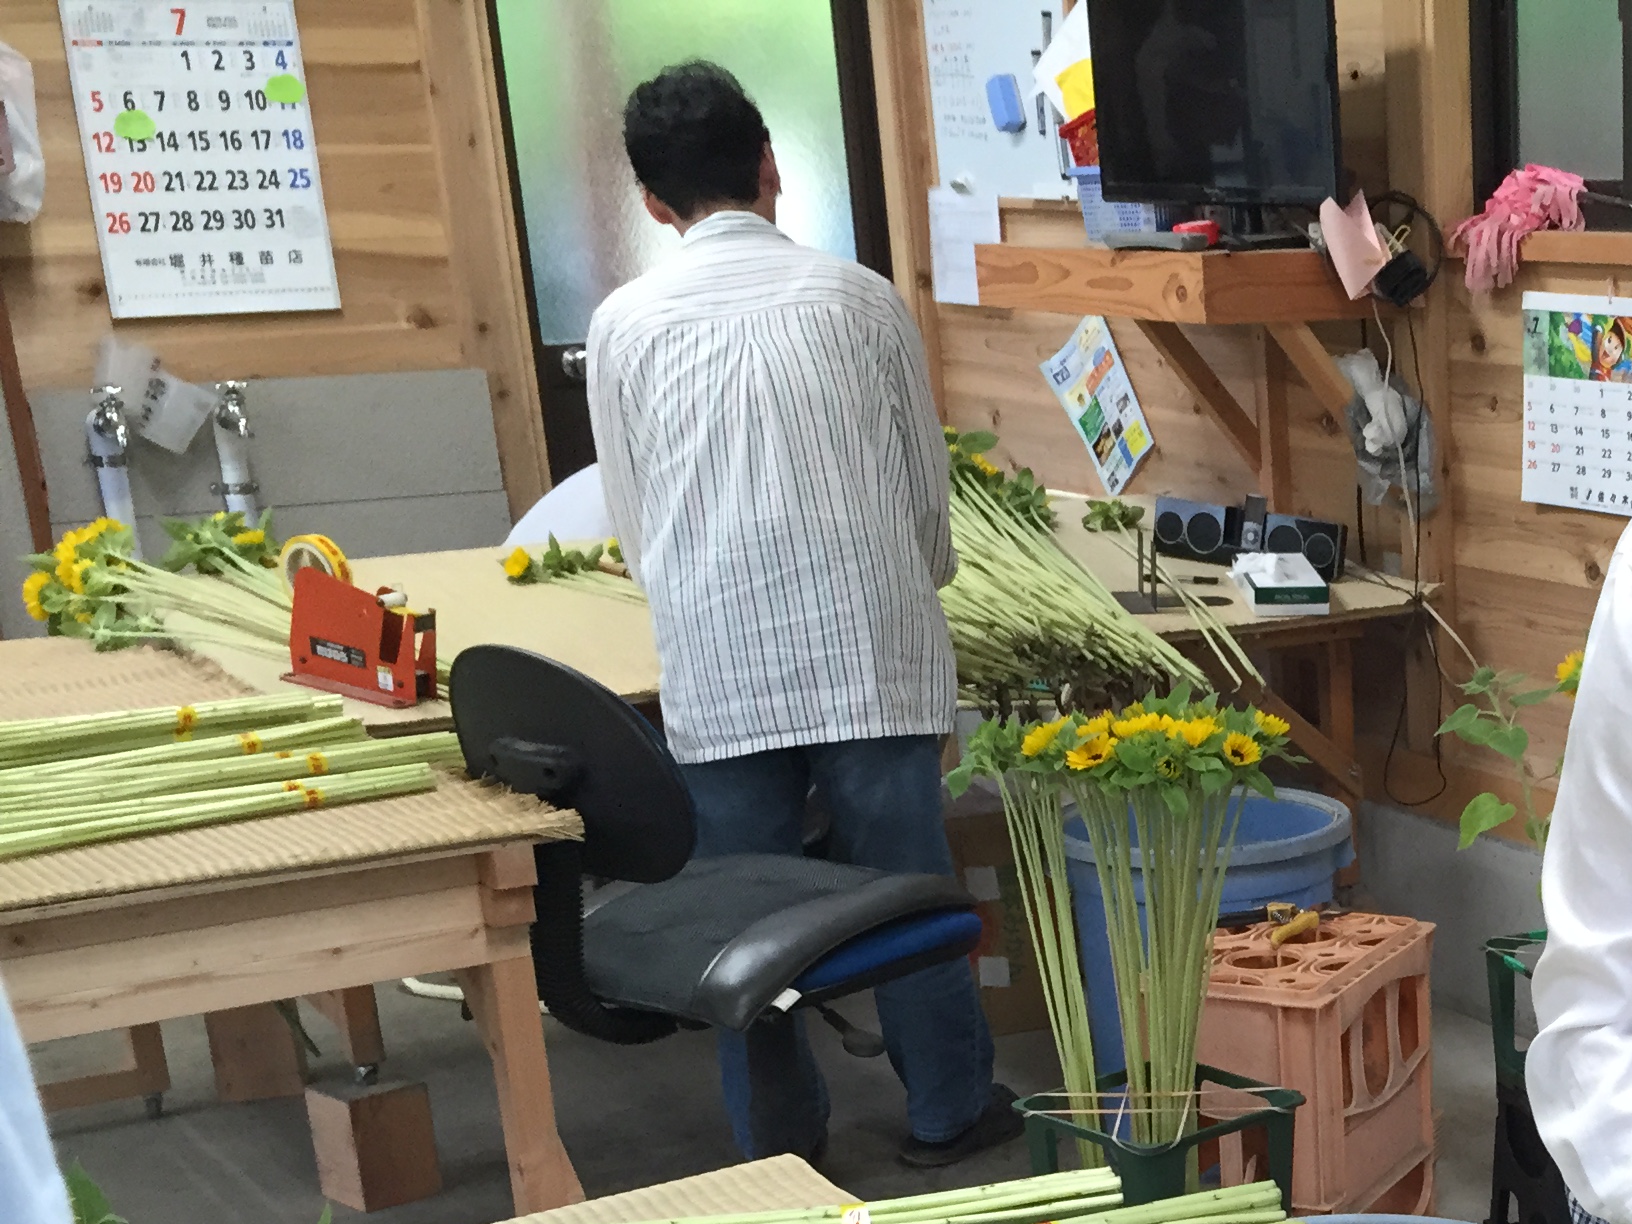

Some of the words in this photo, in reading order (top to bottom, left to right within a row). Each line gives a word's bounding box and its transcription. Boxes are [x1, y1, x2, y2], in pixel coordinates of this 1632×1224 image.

[170, 8, 186, 35] 7
[181, 51, 191, 70] 1
[214, 51, 225, 70] 2
[244, 50, 256, 70] 3
[275, 49, 287, 70] 4
[91, 91, 103, 112] 5
[123, 91, 136, 110] 6
[153, 91, 165, 111] 7
[187, 90, 199, 111] 8
[218, 90, 230, 110] 9
[244, 89, 267, 111] 10
[92, 131, 115, 152] 12
[156, 130, 179, 151] 14
[187, 130, 210, 151] 15
[219, 130, 242, 150] 16
[251, 129, 271, 150] 17
[282, 129, 304, 150] 18
[99, 172, 122, 193] 19
[131, 171, 155, 192] 20
[163, 170, 184, 192] 21
[194, 170, 218, 191] 22
[226, 169, 249, 191] 23
[256, 169, 280, 190] 24
[288, 168, 311, 189] 25
[106, 212, 131, 234] 26
[138, 212, 160, 232] 27
[170, 211, 194, 231] 28
[201, 210, 224, 230] 29
[232, 209, 256, 229] 30
[264, 208, 285, 228] 31
